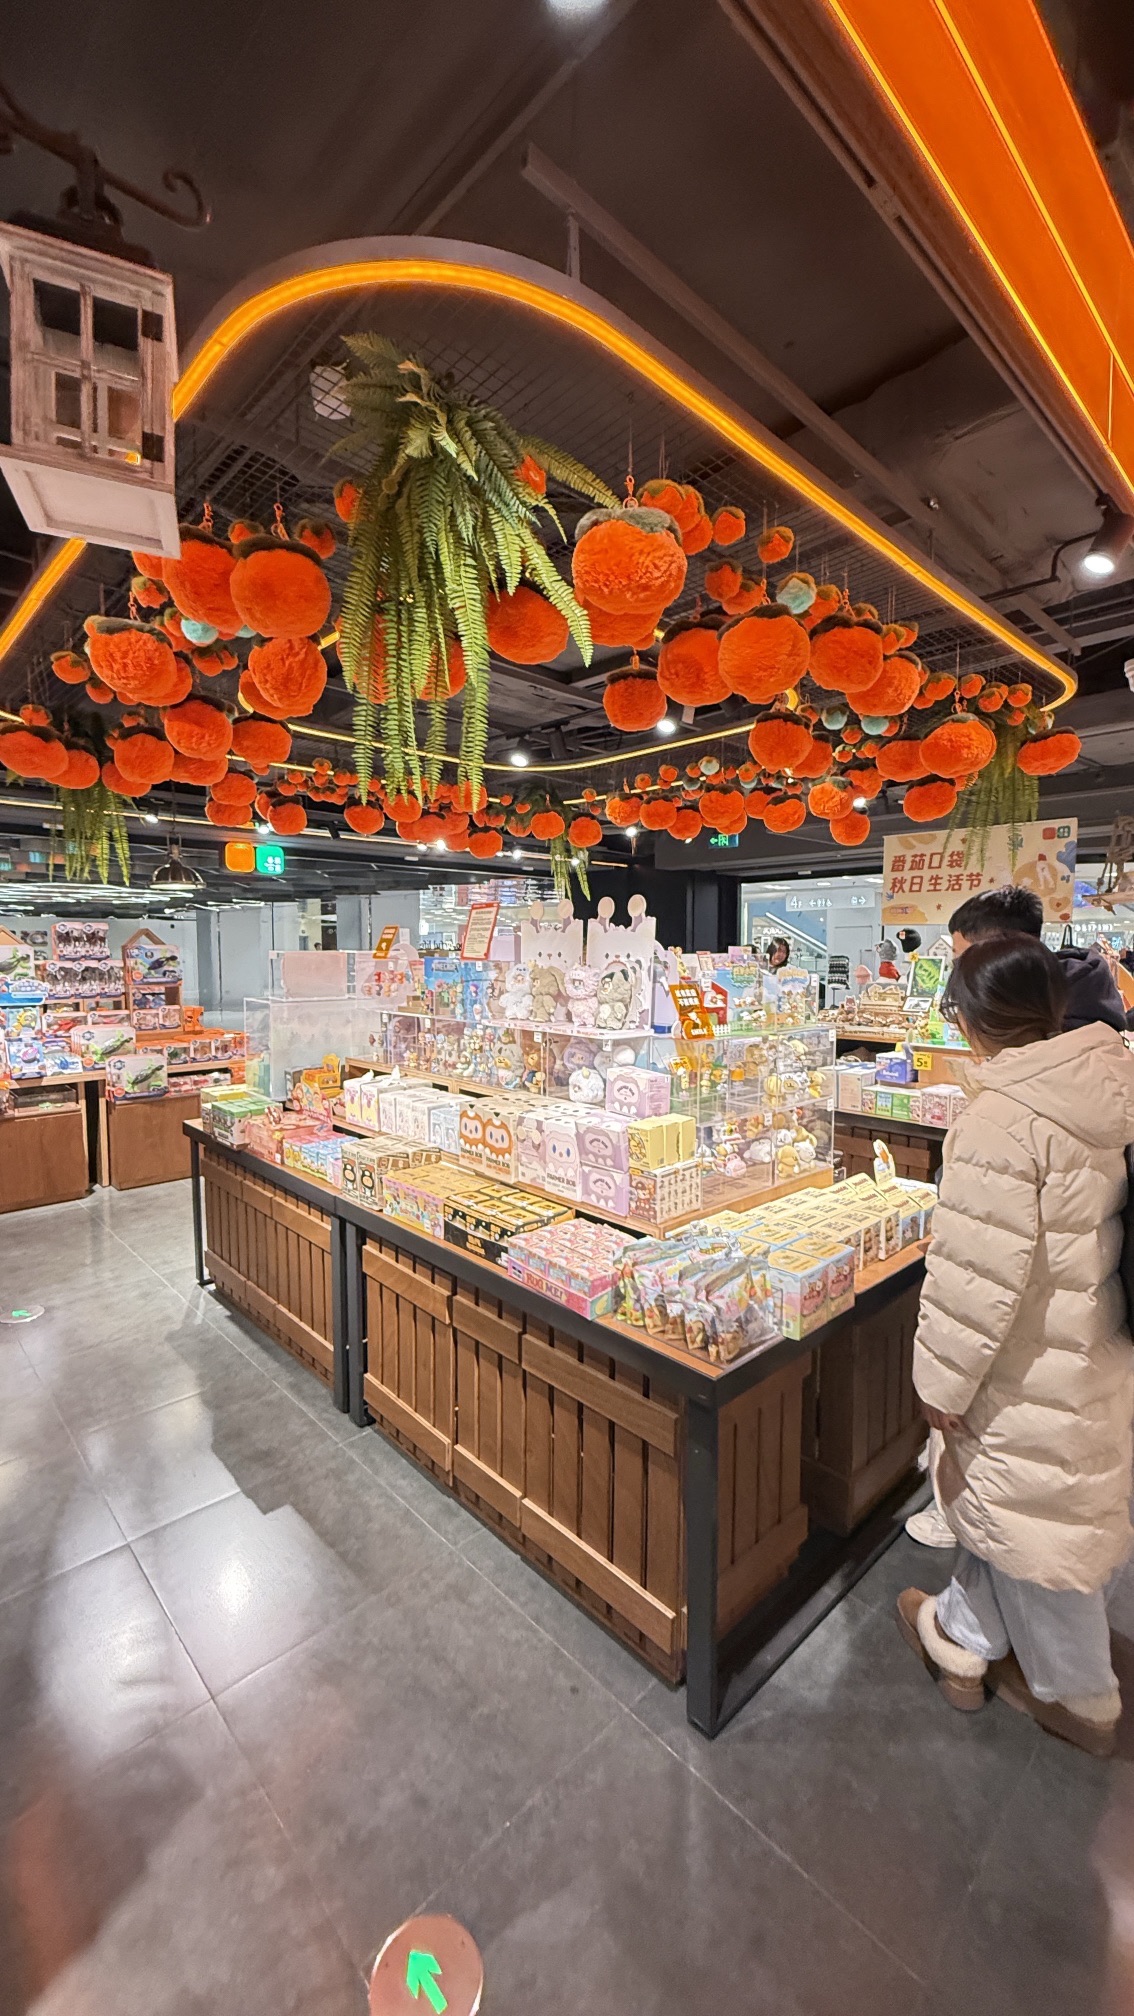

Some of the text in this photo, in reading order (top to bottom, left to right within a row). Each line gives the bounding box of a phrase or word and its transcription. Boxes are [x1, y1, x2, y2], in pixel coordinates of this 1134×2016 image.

[890, 850, 965, 873] 番茄口袋
[889, 872, 984, 894] 秋日生活节
[916, 1057, 923, 1068] 5
[546, 1172, 577, 1188] FARMER BOB
